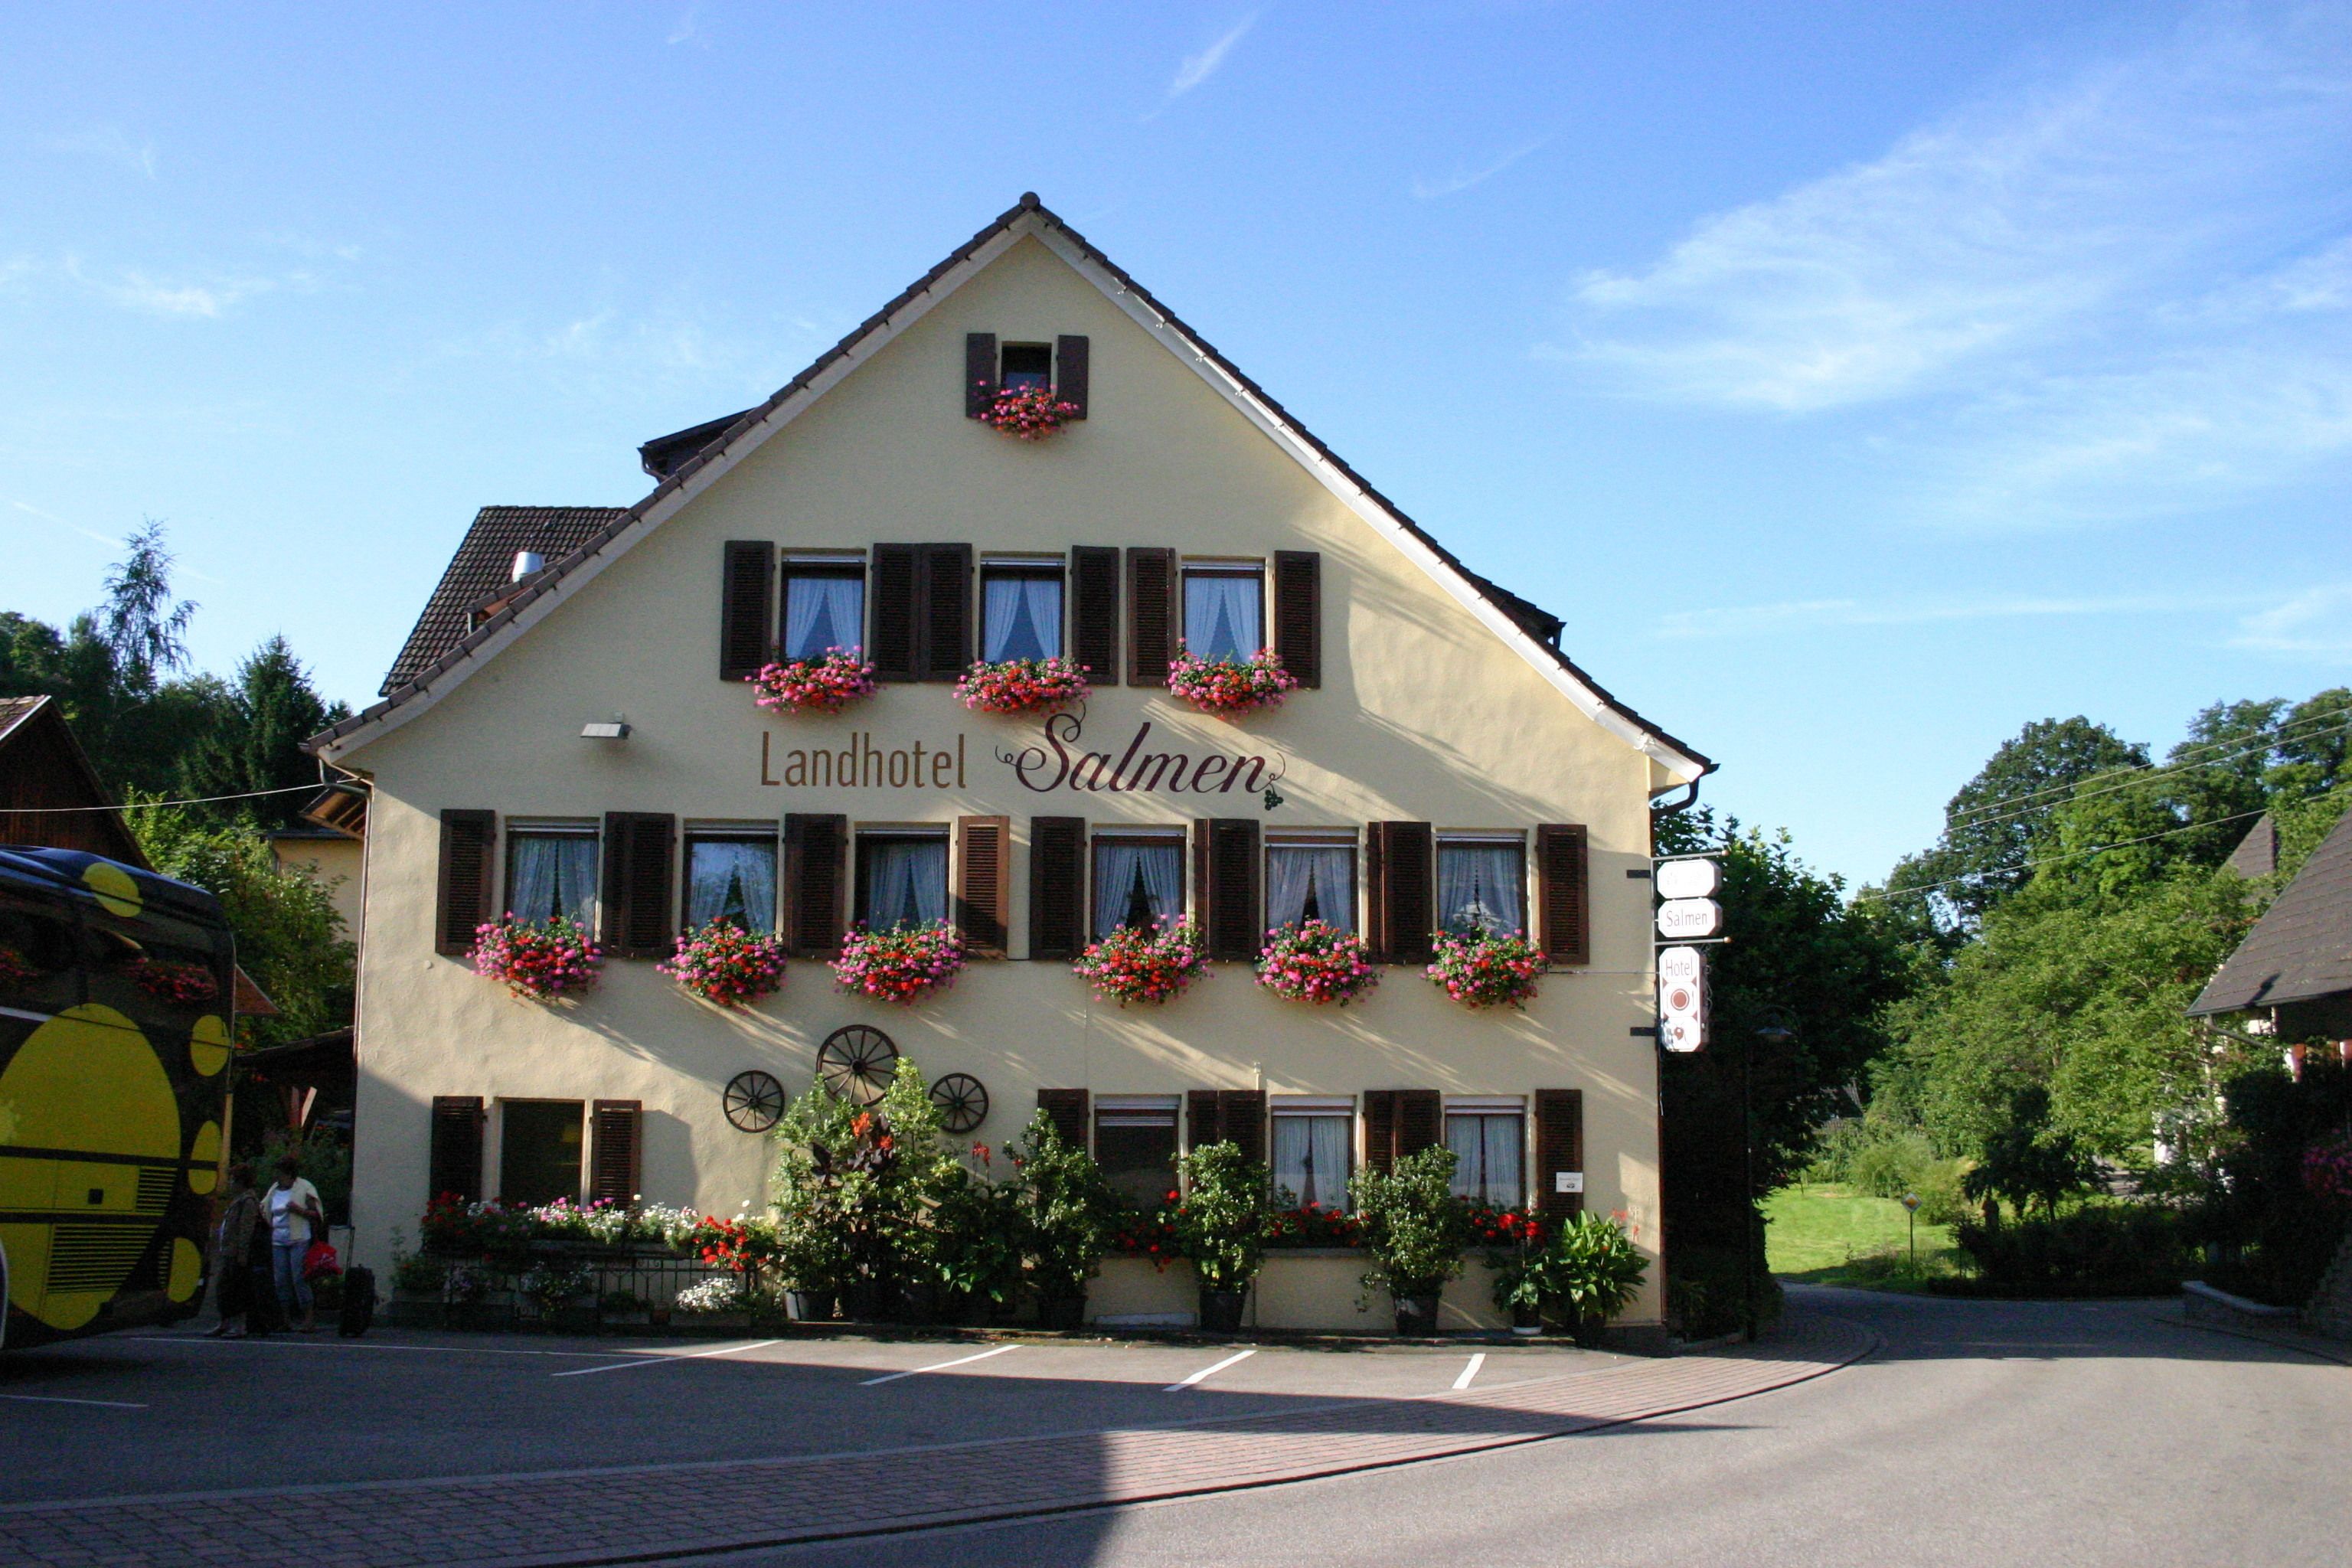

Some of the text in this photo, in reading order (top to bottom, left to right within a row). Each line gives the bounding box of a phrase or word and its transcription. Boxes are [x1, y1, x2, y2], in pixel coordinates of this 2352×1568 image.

[761, 701, 1286, 794] Landhotel Salmen
[1666, 910, 1707, 927] Salmen
[1665, 957, 1693, 977] Hotel
